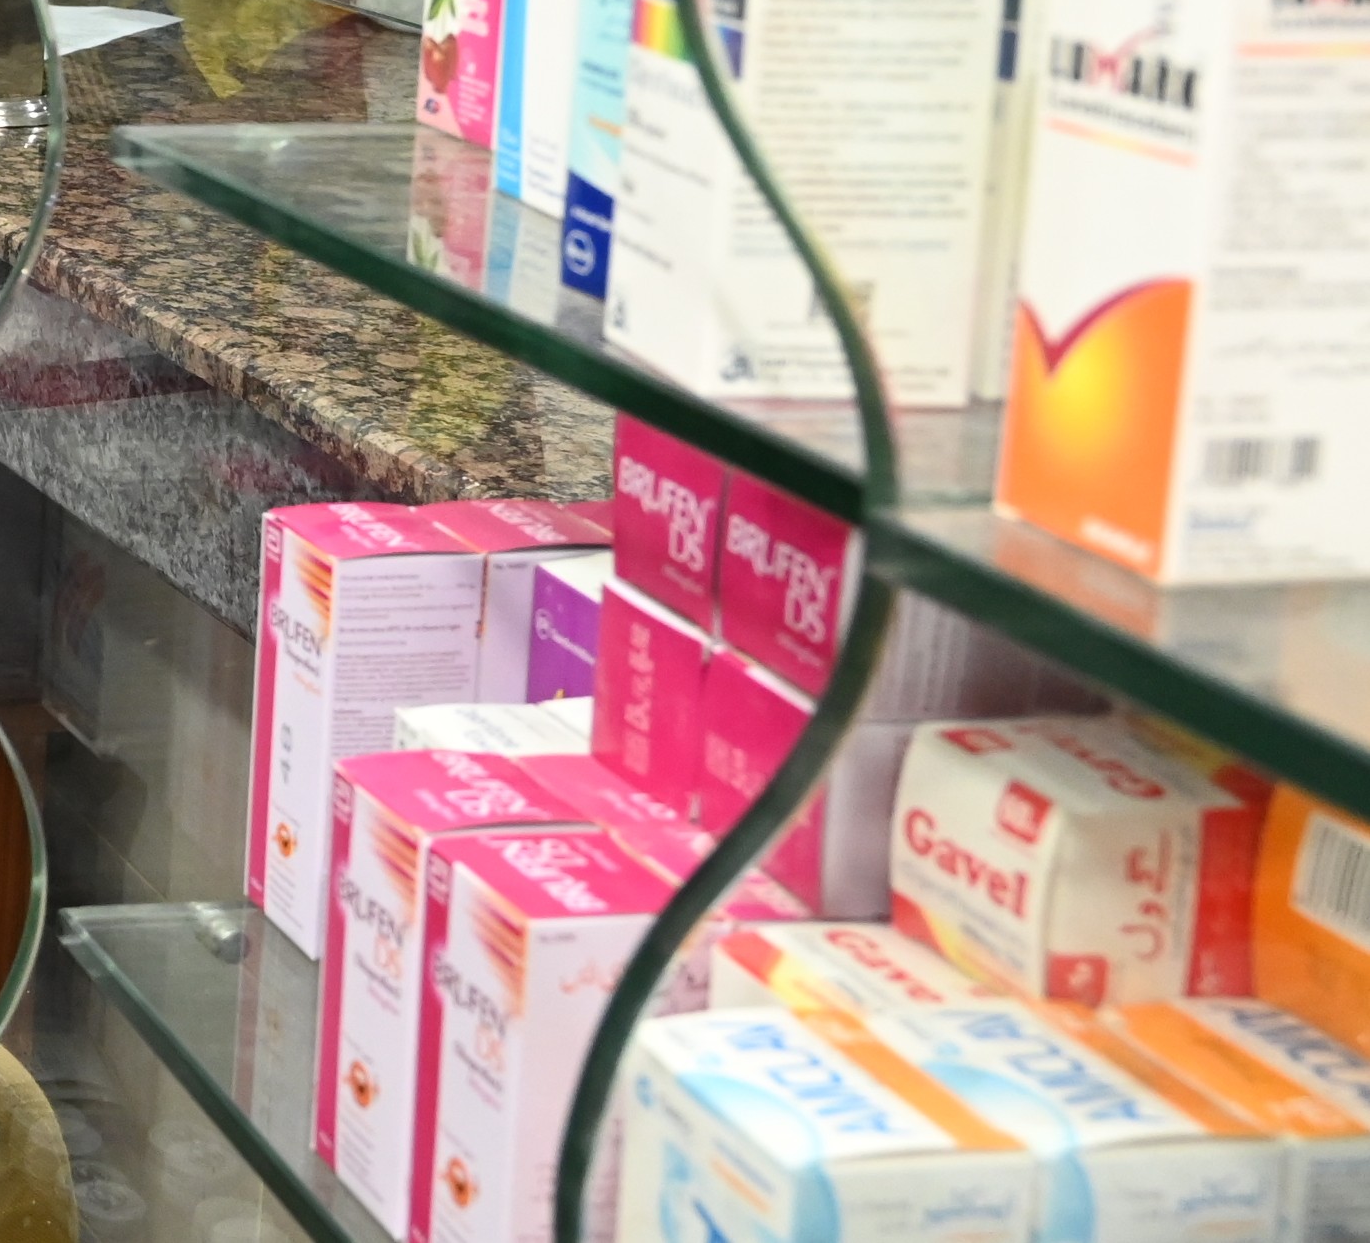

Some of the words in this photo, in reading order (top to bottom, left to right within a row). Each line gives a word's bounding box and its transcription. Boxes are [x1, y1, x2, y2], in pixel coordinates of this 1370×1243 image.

[617, 455, 713, 528] BRUFEN
[726, 514, 839, 598] BRUFEN
[902, 808, 1031, 921] Gavel
